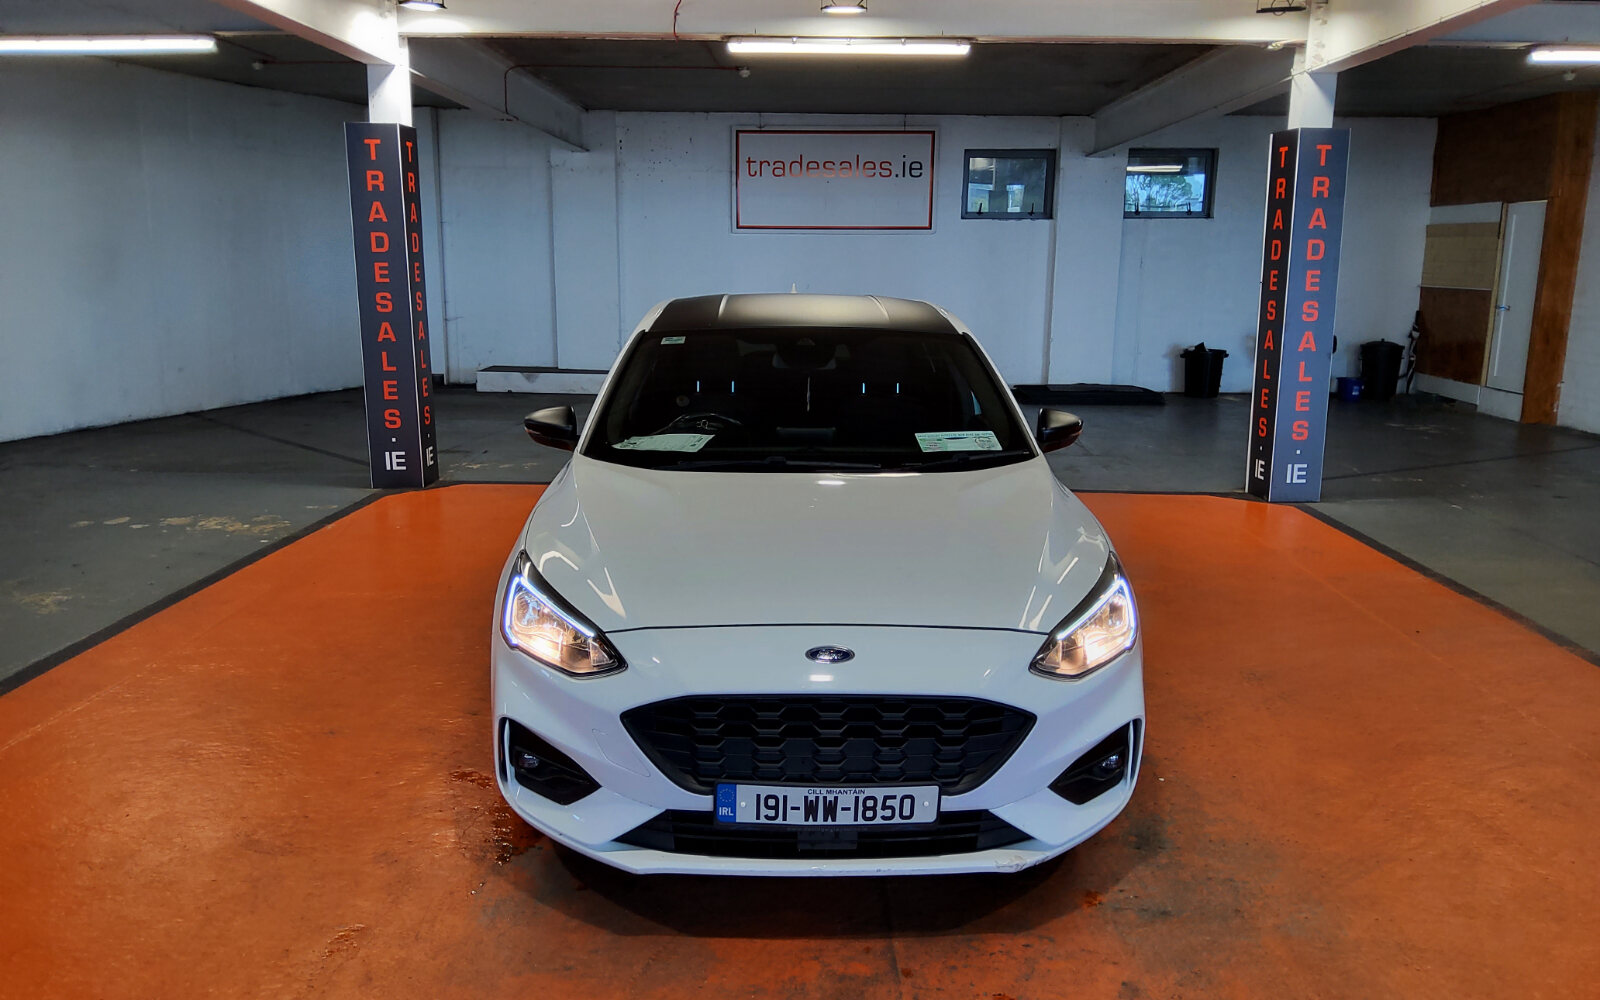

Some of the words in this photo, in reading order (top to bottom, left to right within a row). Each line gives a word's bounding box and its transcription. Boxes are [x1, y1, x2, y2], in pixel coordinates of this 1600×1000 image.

[746, 154, 923, 178] tradesales.ie
[718, 806, 734, 816] IRL
[755, 793, 916, 823] 191-WW-1850
